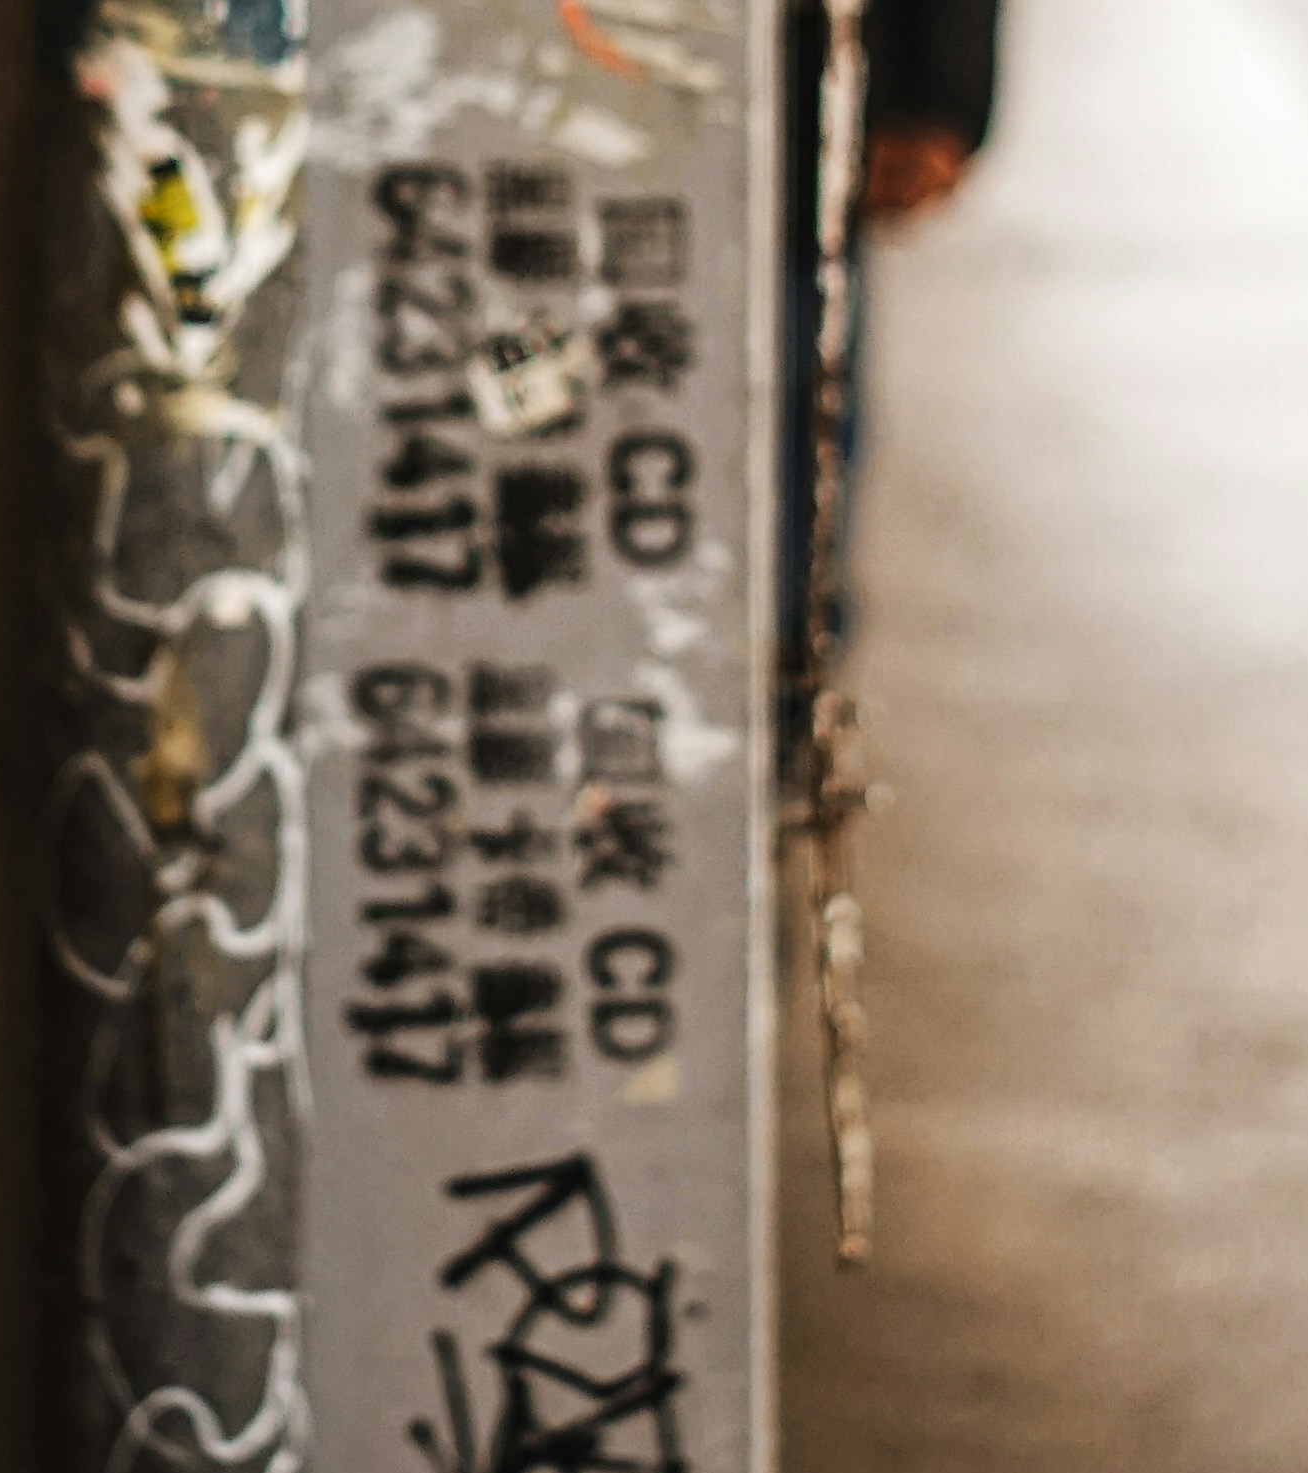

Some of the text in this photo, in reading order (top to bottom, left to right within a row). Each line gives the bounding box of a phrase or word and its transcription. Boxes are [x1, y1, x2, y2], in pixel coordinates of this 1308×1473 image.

[368, 158, 485, 594] 64231417
[607, 430, 697, 567] CD
[343, 660, 465, 1088] 64231417
[584, 926, 679, 1062] CD
